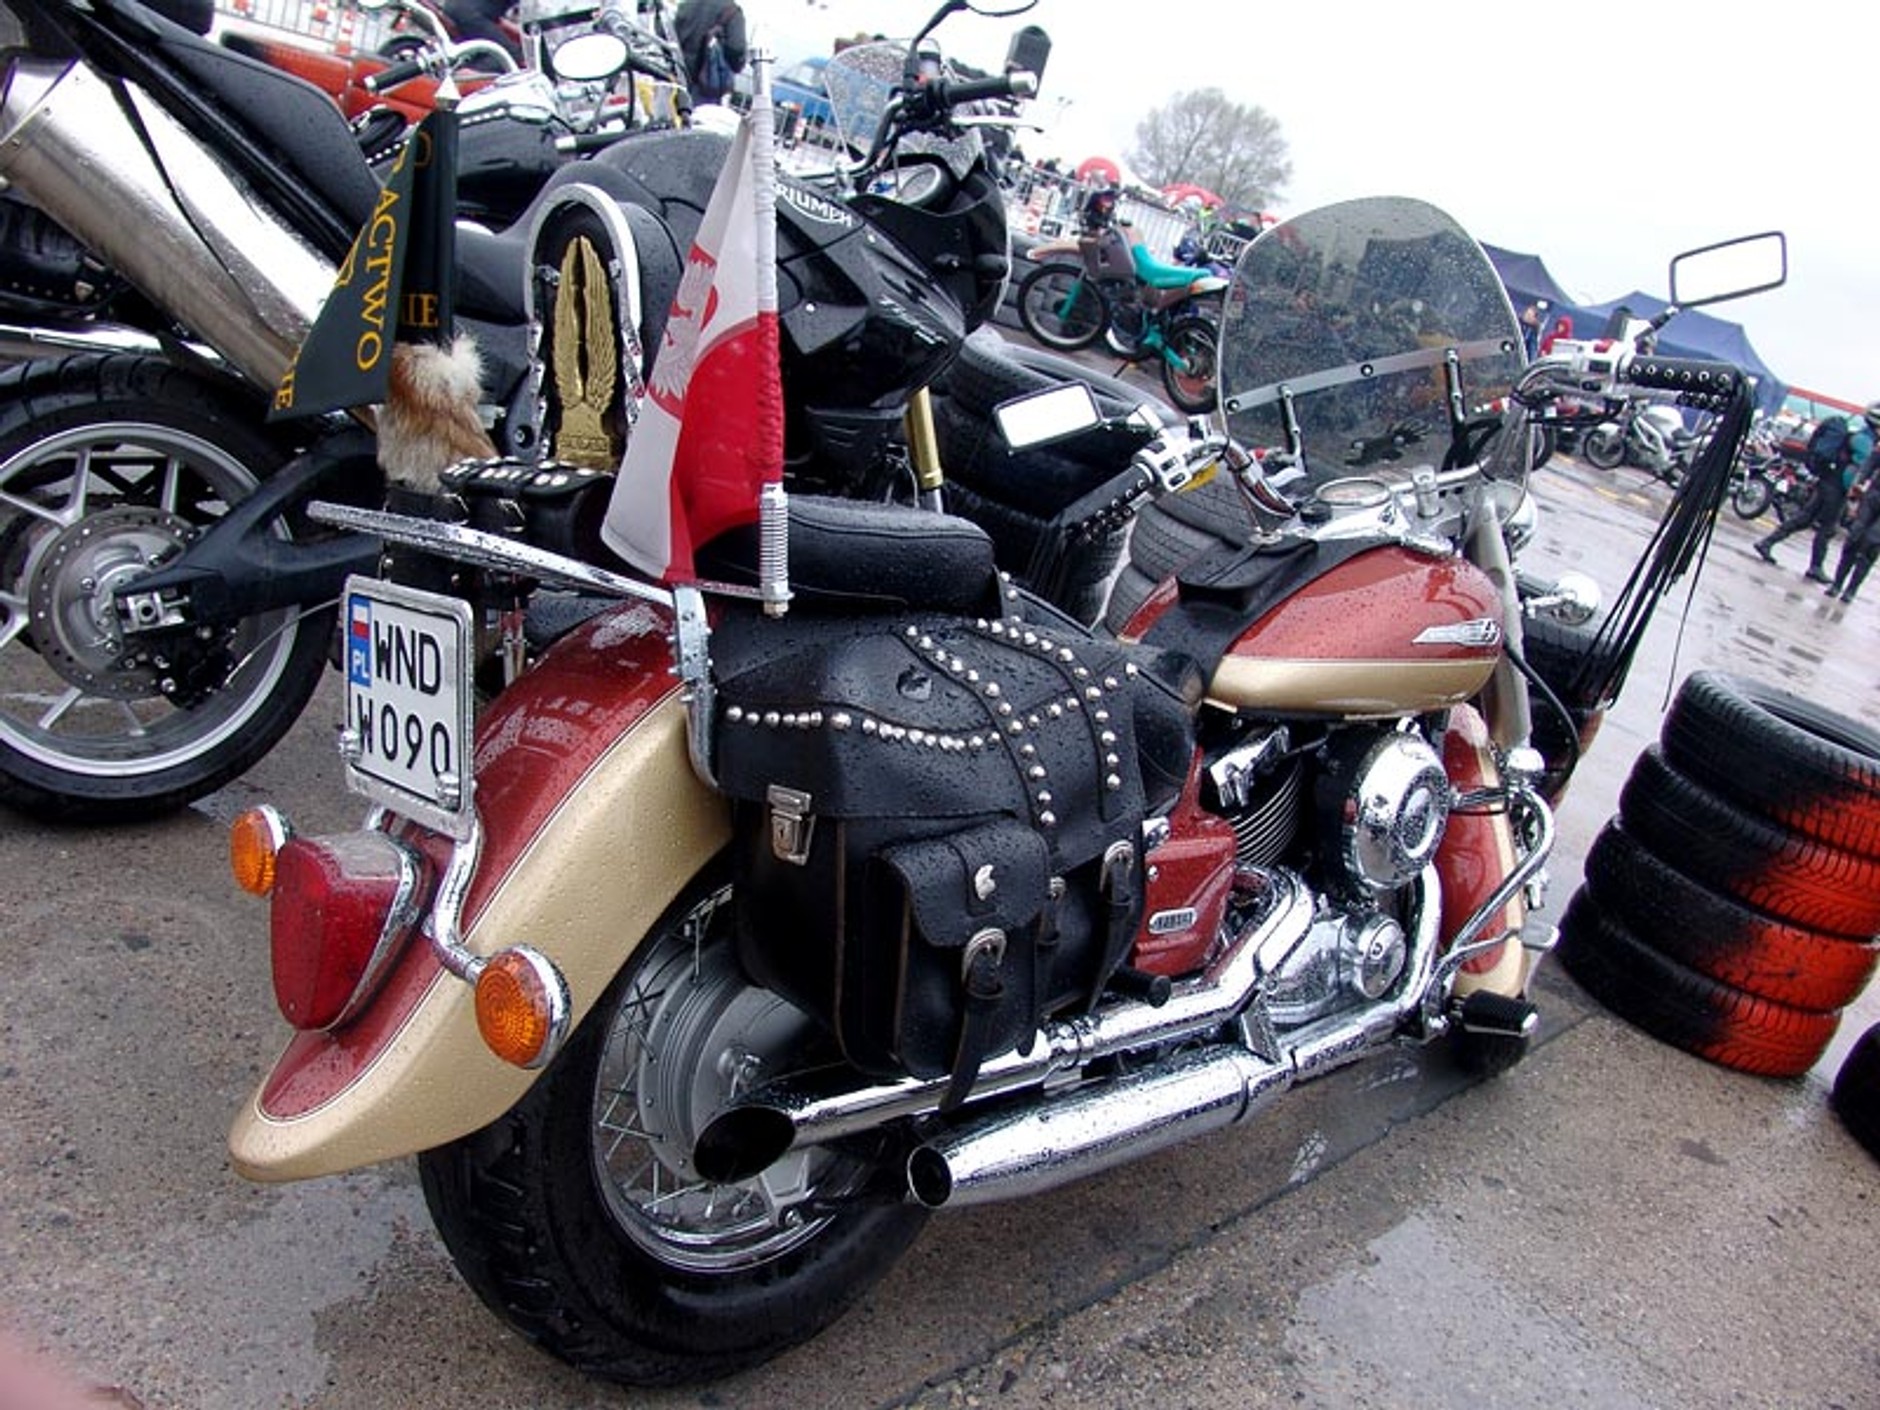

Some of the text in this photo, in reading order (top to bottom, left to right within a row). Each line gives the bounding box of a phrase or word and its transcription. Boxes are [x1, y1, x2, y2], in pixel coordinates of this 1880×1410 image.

[773, 183, 852, 228] RIUMPH
[352, 654, 370, 679] PL
[374, 620, 441, 696] WND
[357, 693, 450, 779] W090
